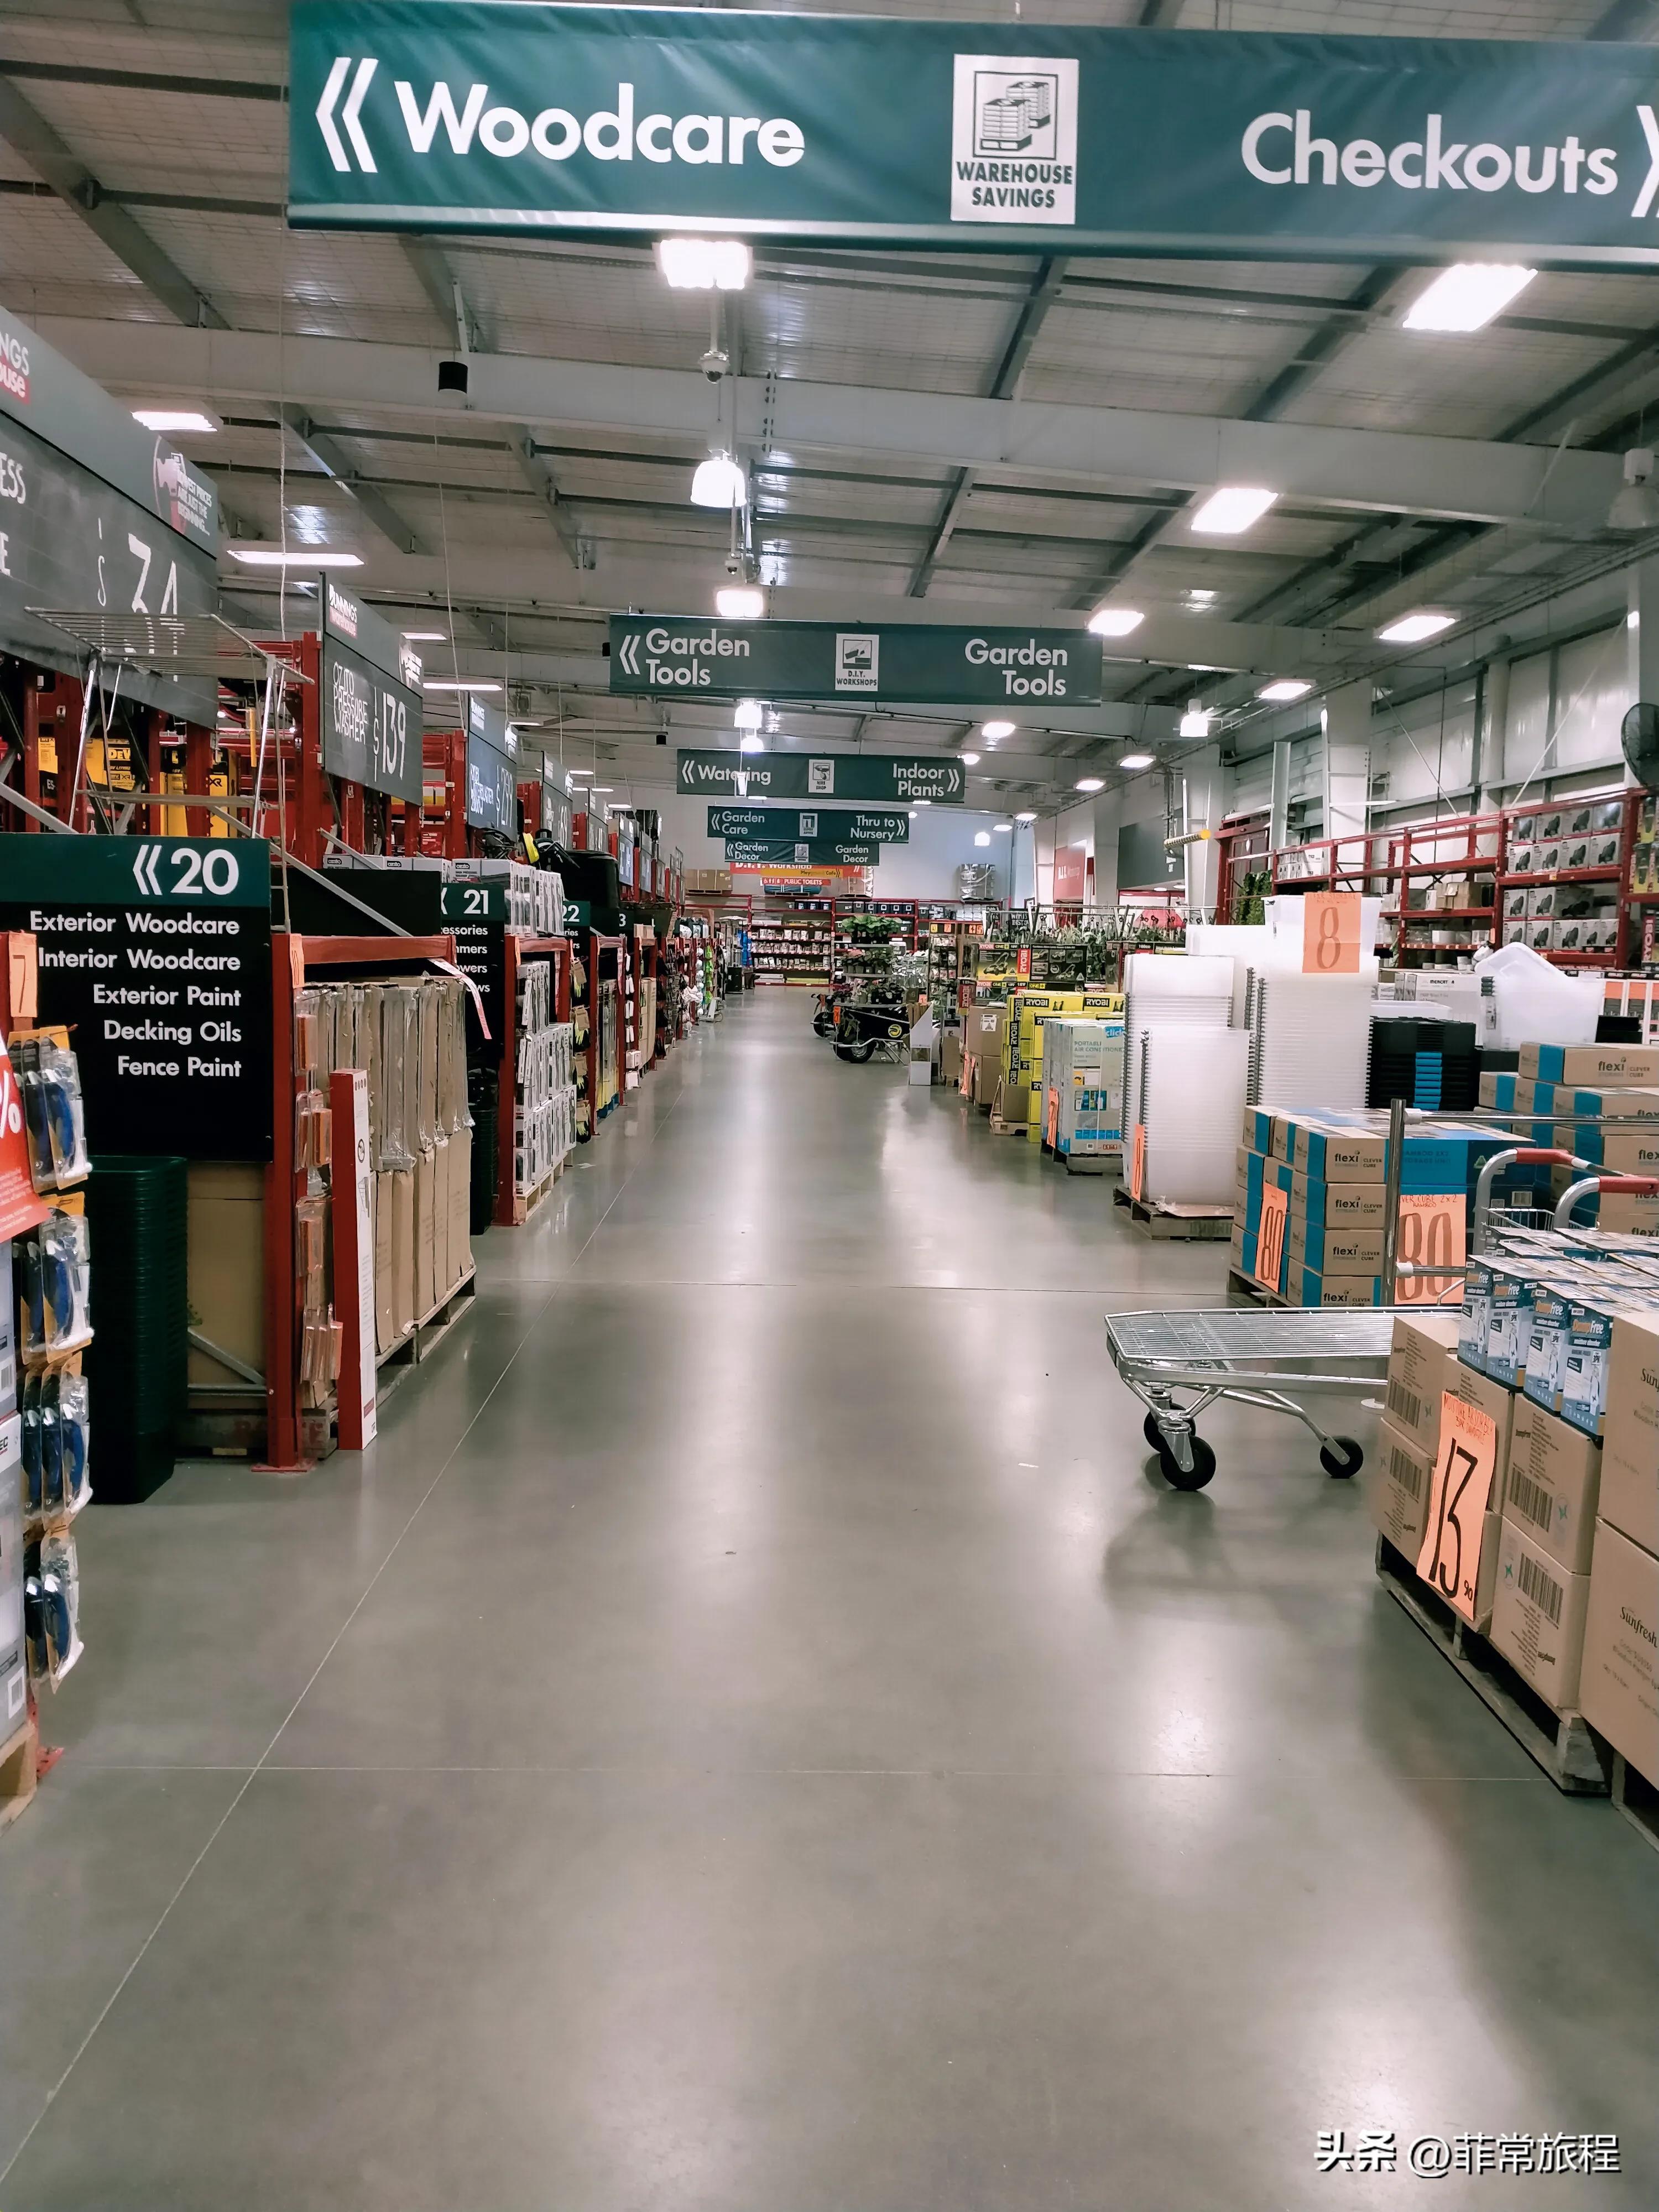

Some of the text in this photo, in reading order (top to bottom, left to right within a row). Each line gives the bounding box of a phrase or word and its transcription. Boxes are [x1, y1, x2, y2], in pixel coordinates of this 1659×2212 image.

[394, 81, 805, 167] Woodcare
[1241, 109, 1619, 196] Checkouts
[957, 161, 1073, 186] WAREHOUSE
[972, 186, 1056, 208] SAVINGS
[646, 628, 750, 656] Garden
[965, 638, 1067, 666] Garden
[333, 661, 354, 696] OZITO
[646, 659, 711, 686] Tools
[837, 677, 878, 687] WORKSHOPS
[1002, 670, 1066, 696] Tools
[334, 706, 366, 745] WASHER
[382, 691, 406, 780] 139
[698, 764, 771, 785] Wateing
[893, 763, 945, 780] Indoor
[898, 781, 945, 797] Plants
[722, 811, 765, 823] Garden
[722, 823, 748, 834] Care
[856, 815, 895, 827] Thru to
[850, 828, 895, 842] Nursery
[735, 842, 769, 852] Garden
[735, 852, 760, 860] Decor
[836, 844, 869, 853] Garden
[843, 854, 868, 863] Decor
[170, 848, 239, 895] 20
[463, 889, 488, 915] 21
[30, 910, 239, 935] Exterior Woodcare
[441, 925, 488, 936] essories
[1317, 906, 1341, 969] 8
[39, 947, 241, 971] Interior Woodcare
[13, 954, 26, 1013] 7
[93, 984, 242, 1006] Exterior Paint
[104, 1019, 242, 1045] Decking Oils
[118, 1056, 242, 1077] Fence Paint
[1598, 1058, 1625, 1072] flexi
[1135, 1137, 1141, 1194] 8
[1334, 1152, 1359, 1163] flexi
[1335, 1197, 1360, 1209] flexi
[1418, 1194, 1435, 1203] CUBE
[1260, 1206, 1284, 1281] 80
[1333, 1245, 1357, 1255] flexi
[1396, 1212, 1452, 1301] 80
[1323, 1291, 1348, 1302] flexi
[1428, 1437, 1479, 1599] 13
[1620, 1606, 1658, 1648] Sunfresh
